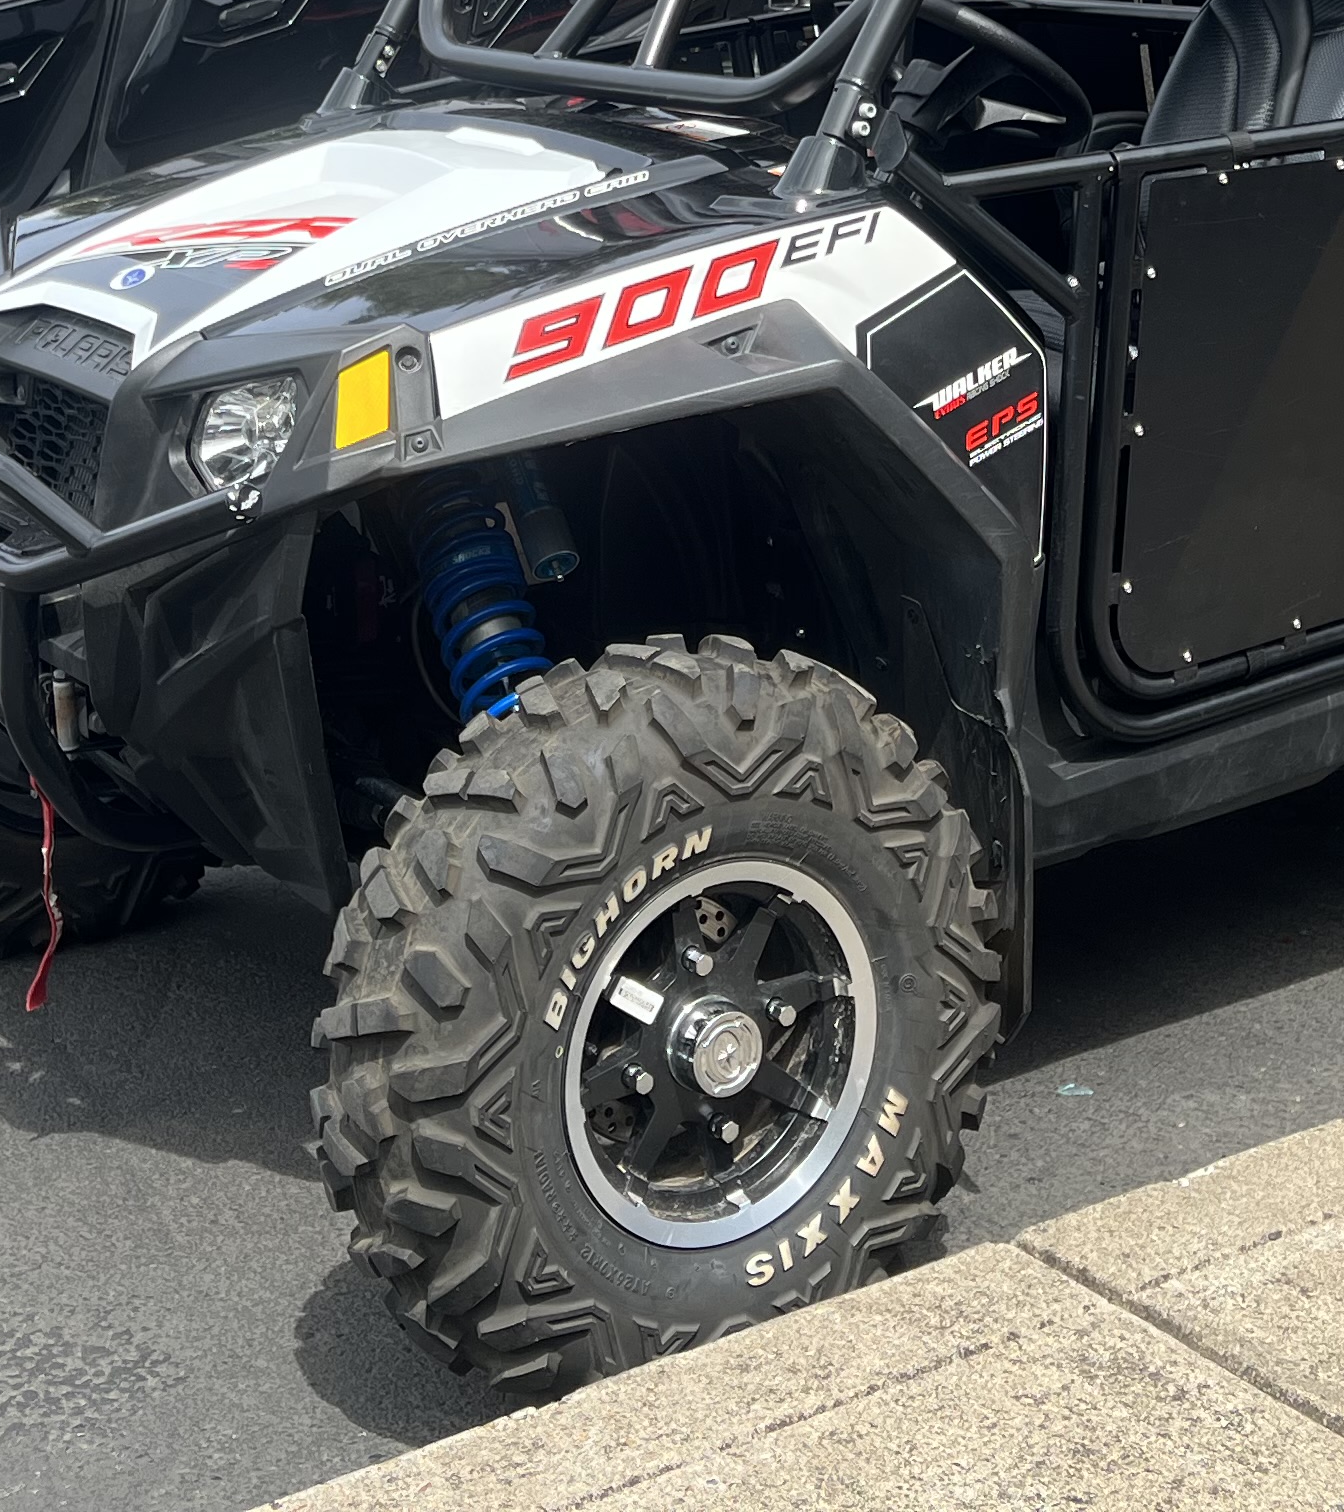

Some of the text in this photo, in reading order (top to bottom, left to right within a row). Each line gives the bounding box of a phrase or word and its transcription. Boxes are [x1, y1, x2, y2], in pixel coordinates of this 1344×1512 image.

[15, 315, 133, 380] POLARIS
[503, 210, 882, 384] 900 EFI
[913, 346, 1033, 412] WALKER
[965, 391, 1039, 452] EPS
[543, 824, 714, 1032] BIGHORN
[744, 1086, 910, 1287] MAXXIS
